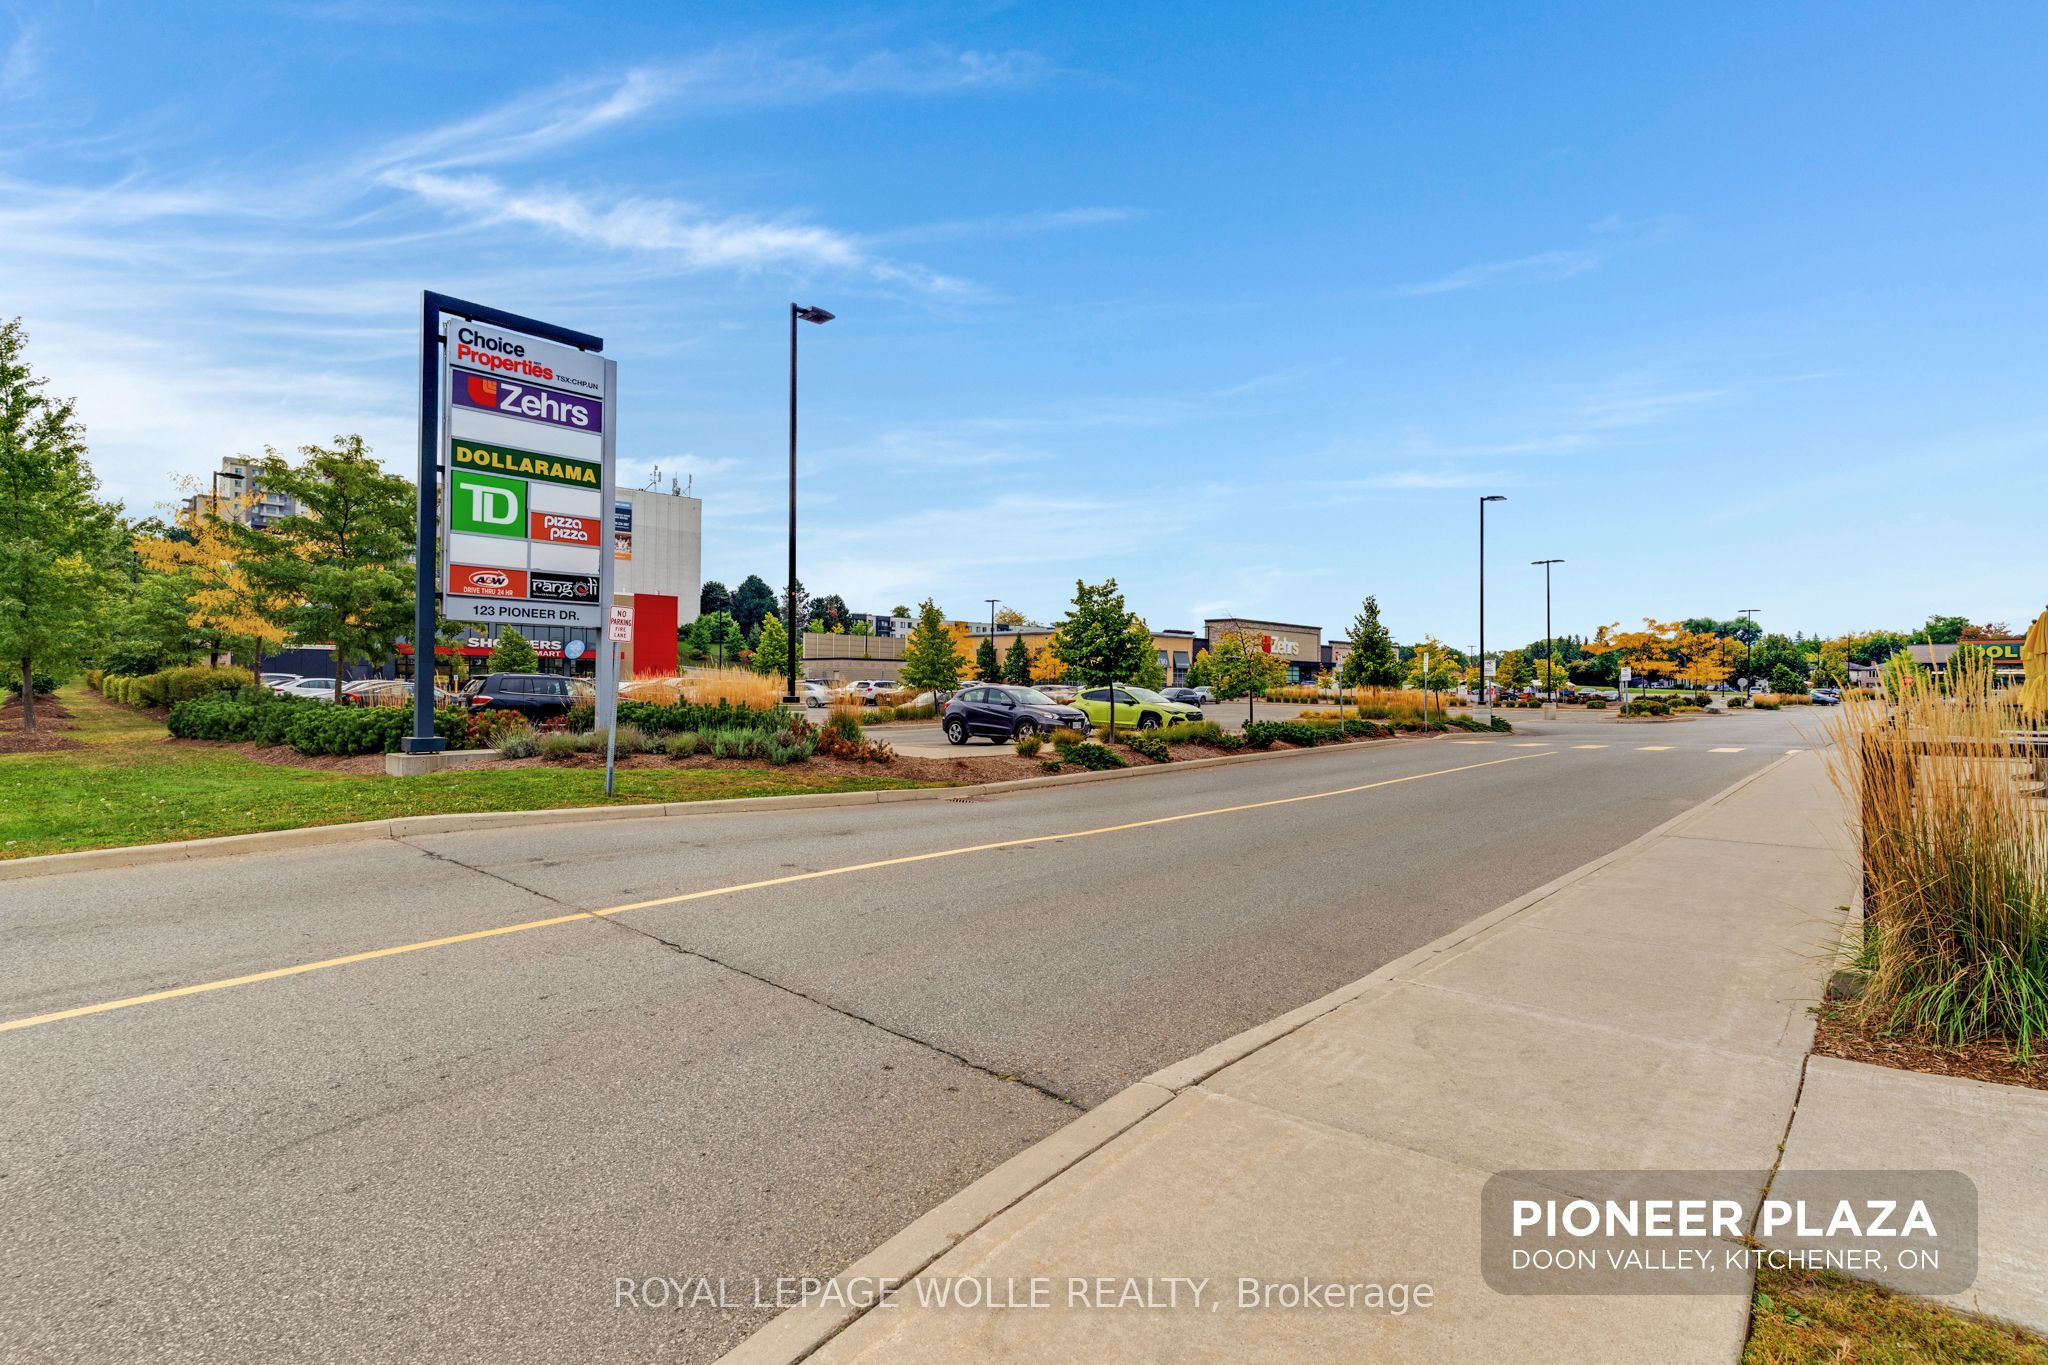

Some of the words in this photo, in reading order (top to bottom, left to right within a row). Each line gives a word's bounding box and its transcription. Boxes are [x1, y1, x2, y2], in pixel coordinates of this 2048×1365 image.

[458, 327, 525, 358] Choice
[457, 343, 553, 381] Properties
[556, 374, 599, 390] TSX:CHP.UN
[500, 382, 589, 427] Zehrs
[456, 446, 596, 484] DOLLARAMA
[460, 482, 519, 525] TD
[544, 515, 582, 530] pizza
[550, 527, 588, 542] pizza
[475, 576, 506, 585] A&W
[531, 577, 598, 598] rangoli
[463, 586, 480, 594] DRIVE
[481, 587, 496, 595] THRU
[497, 588, 505, 596] 24
[472, 605, 495, 617] 123
[499, 607, 556, 620] PIONEER
[559, 610, 580, 621] DR.
[610, 618, 632, 627] PARKING
[467, 637, 562, 651] SHOERS
